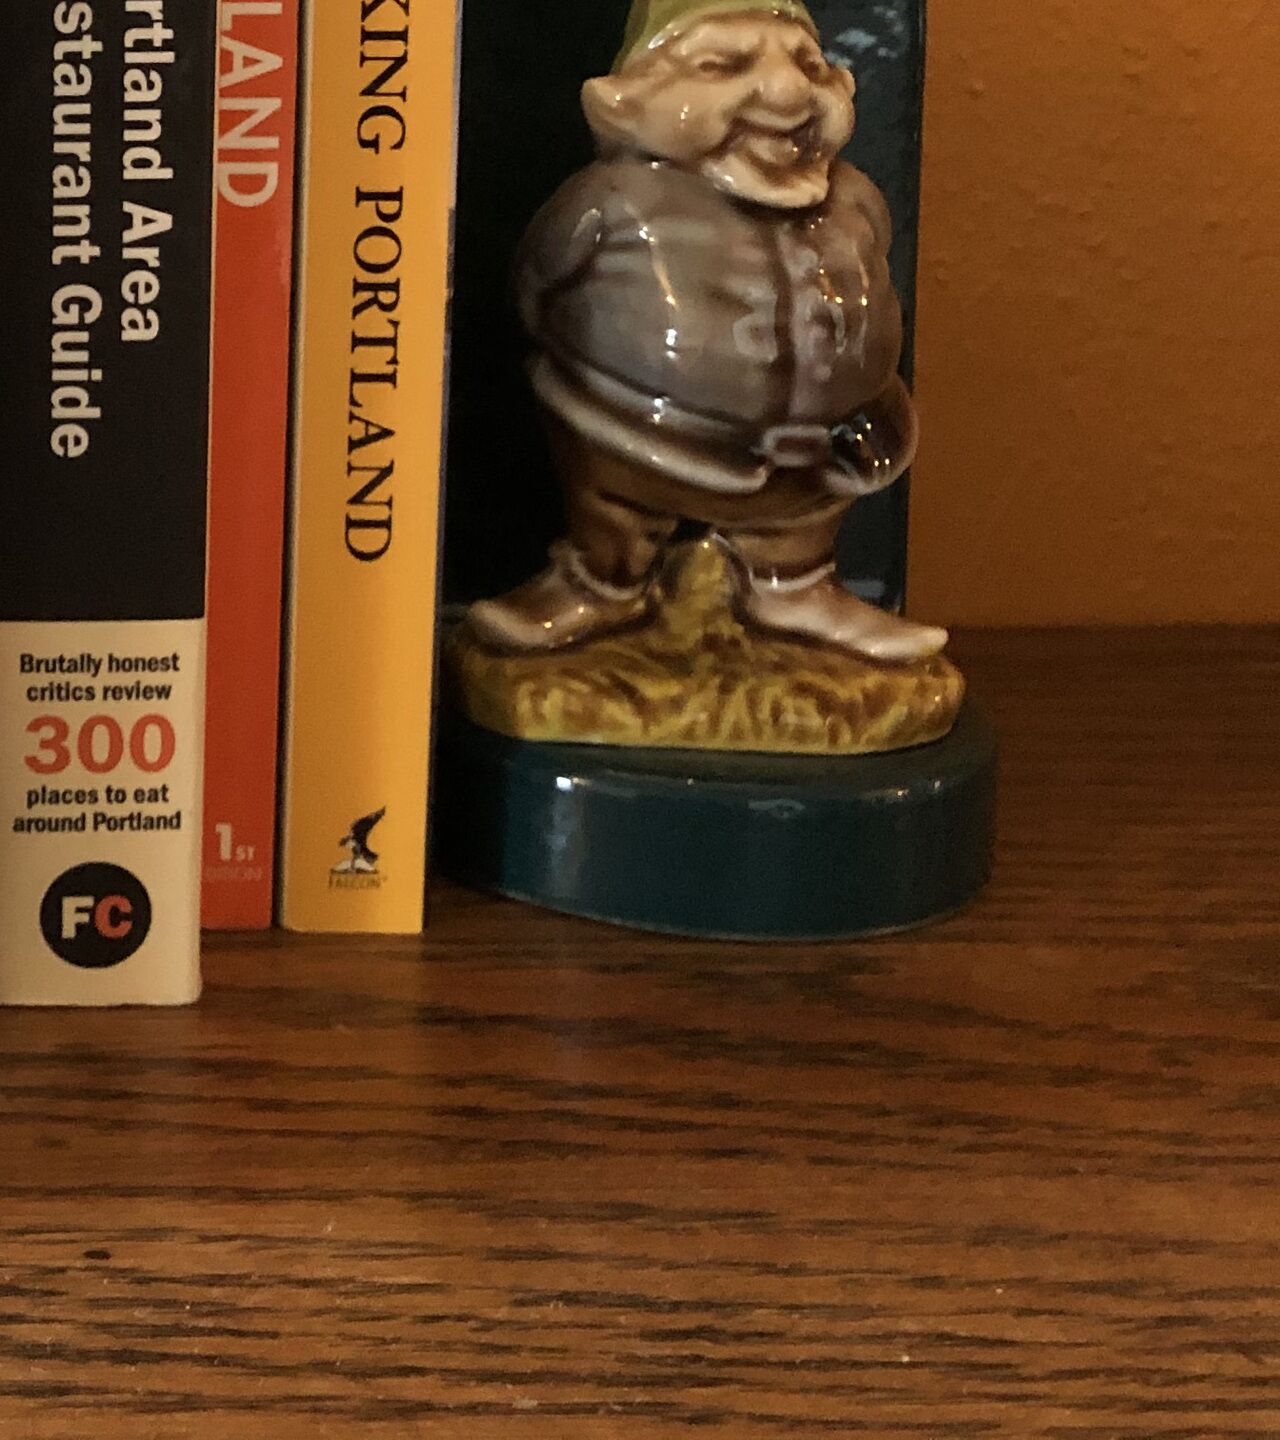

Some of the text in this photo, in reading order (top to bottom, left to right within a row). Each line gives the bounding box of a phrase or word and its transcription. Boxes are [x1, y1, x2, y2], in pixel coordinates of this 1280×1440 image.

[120, 200, 173, 341] Area
[51, 284, 103, 458] Guide
[345, 186, 404, 563] PORTLAND
[19, 653, 180, 676] Brutally honest
[26, 682, 172, 701] critics review
[23, 713, 176, 774] 300
[26, 784, 169, 809] places to eat
[12, 811, 181, 832] around Portland
[61, 895, 133, 939] FC
